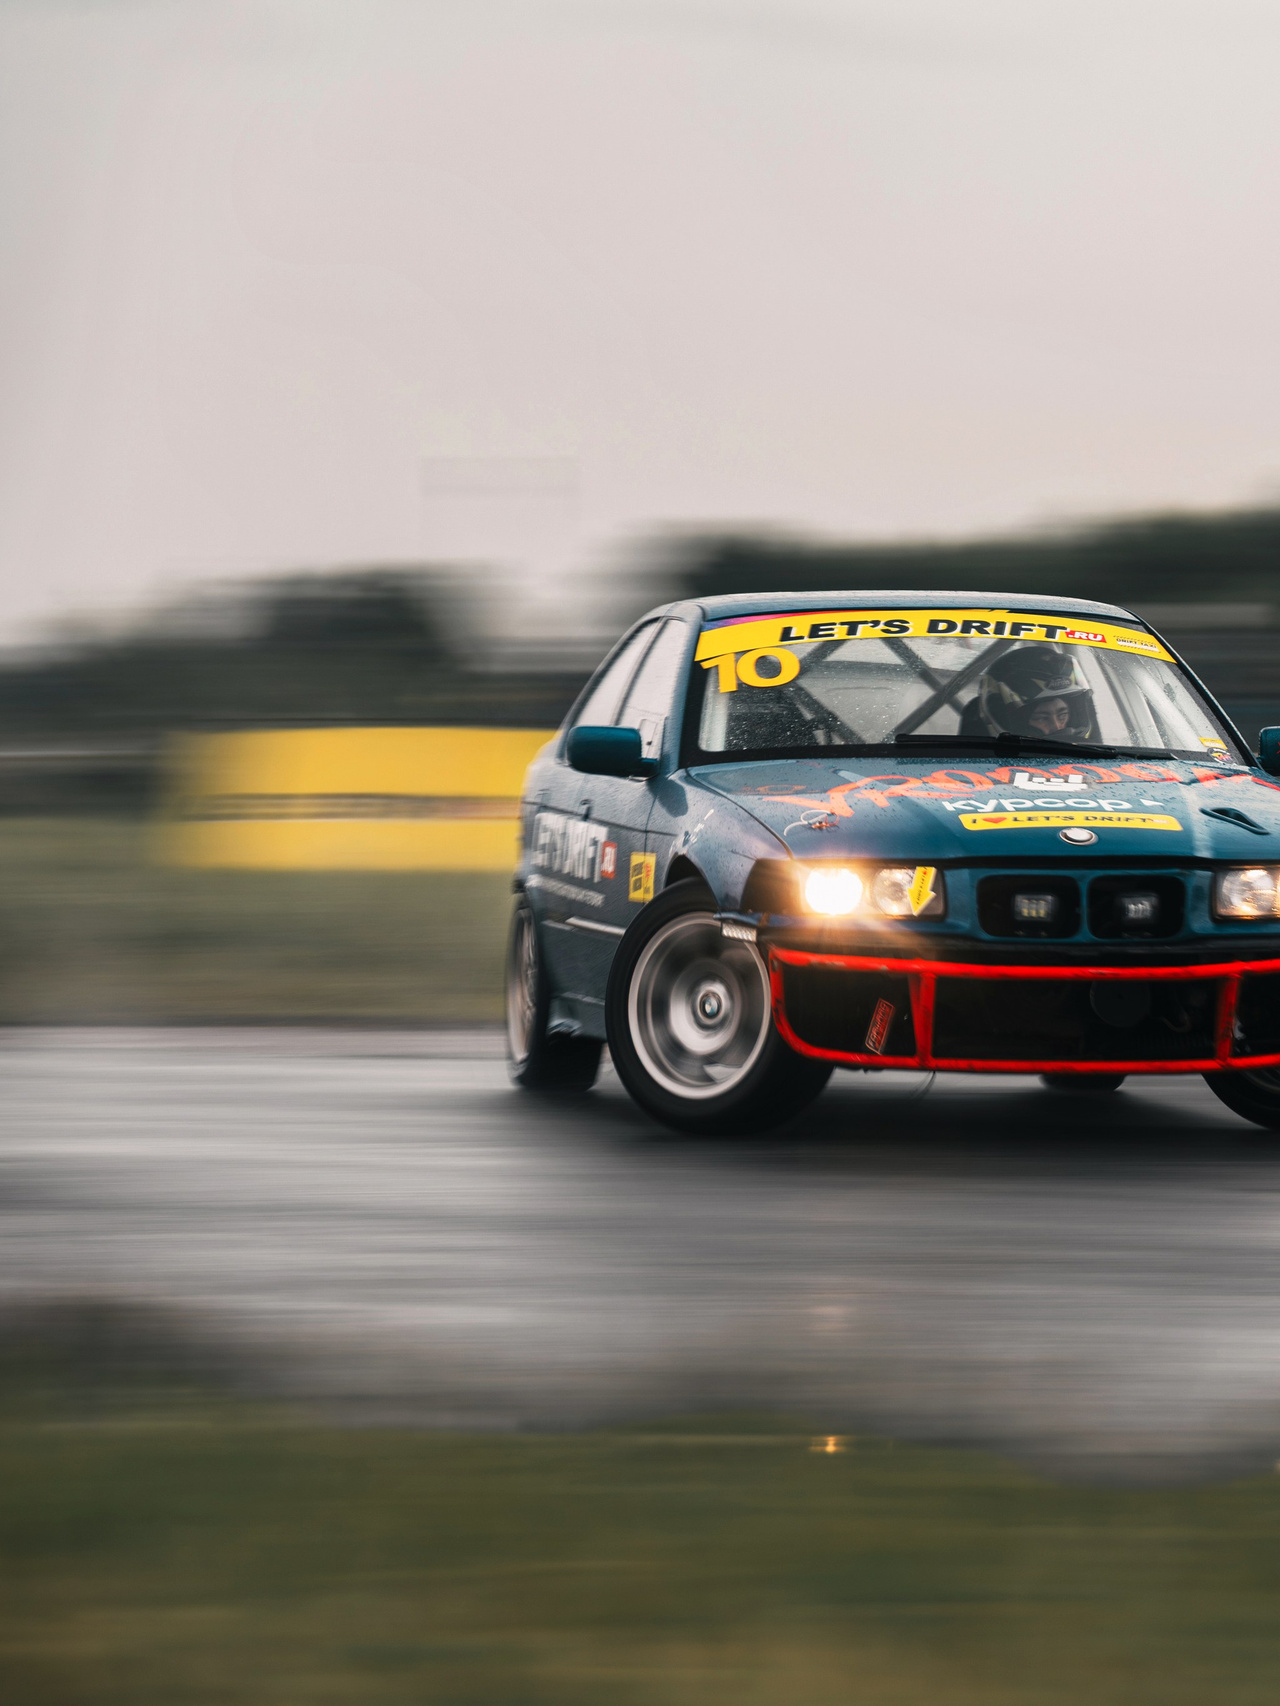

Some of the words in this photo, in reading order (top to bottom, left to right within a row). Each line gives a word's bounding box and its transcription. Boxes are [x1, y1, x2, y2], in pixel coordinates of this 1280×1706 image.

[779, 619, 912, 642] LET'S
[926, 619, 1067, 639] DRIFT
[700, 647, 800, 693] 10
[1084, 815, 1149, 823] DRIFT
